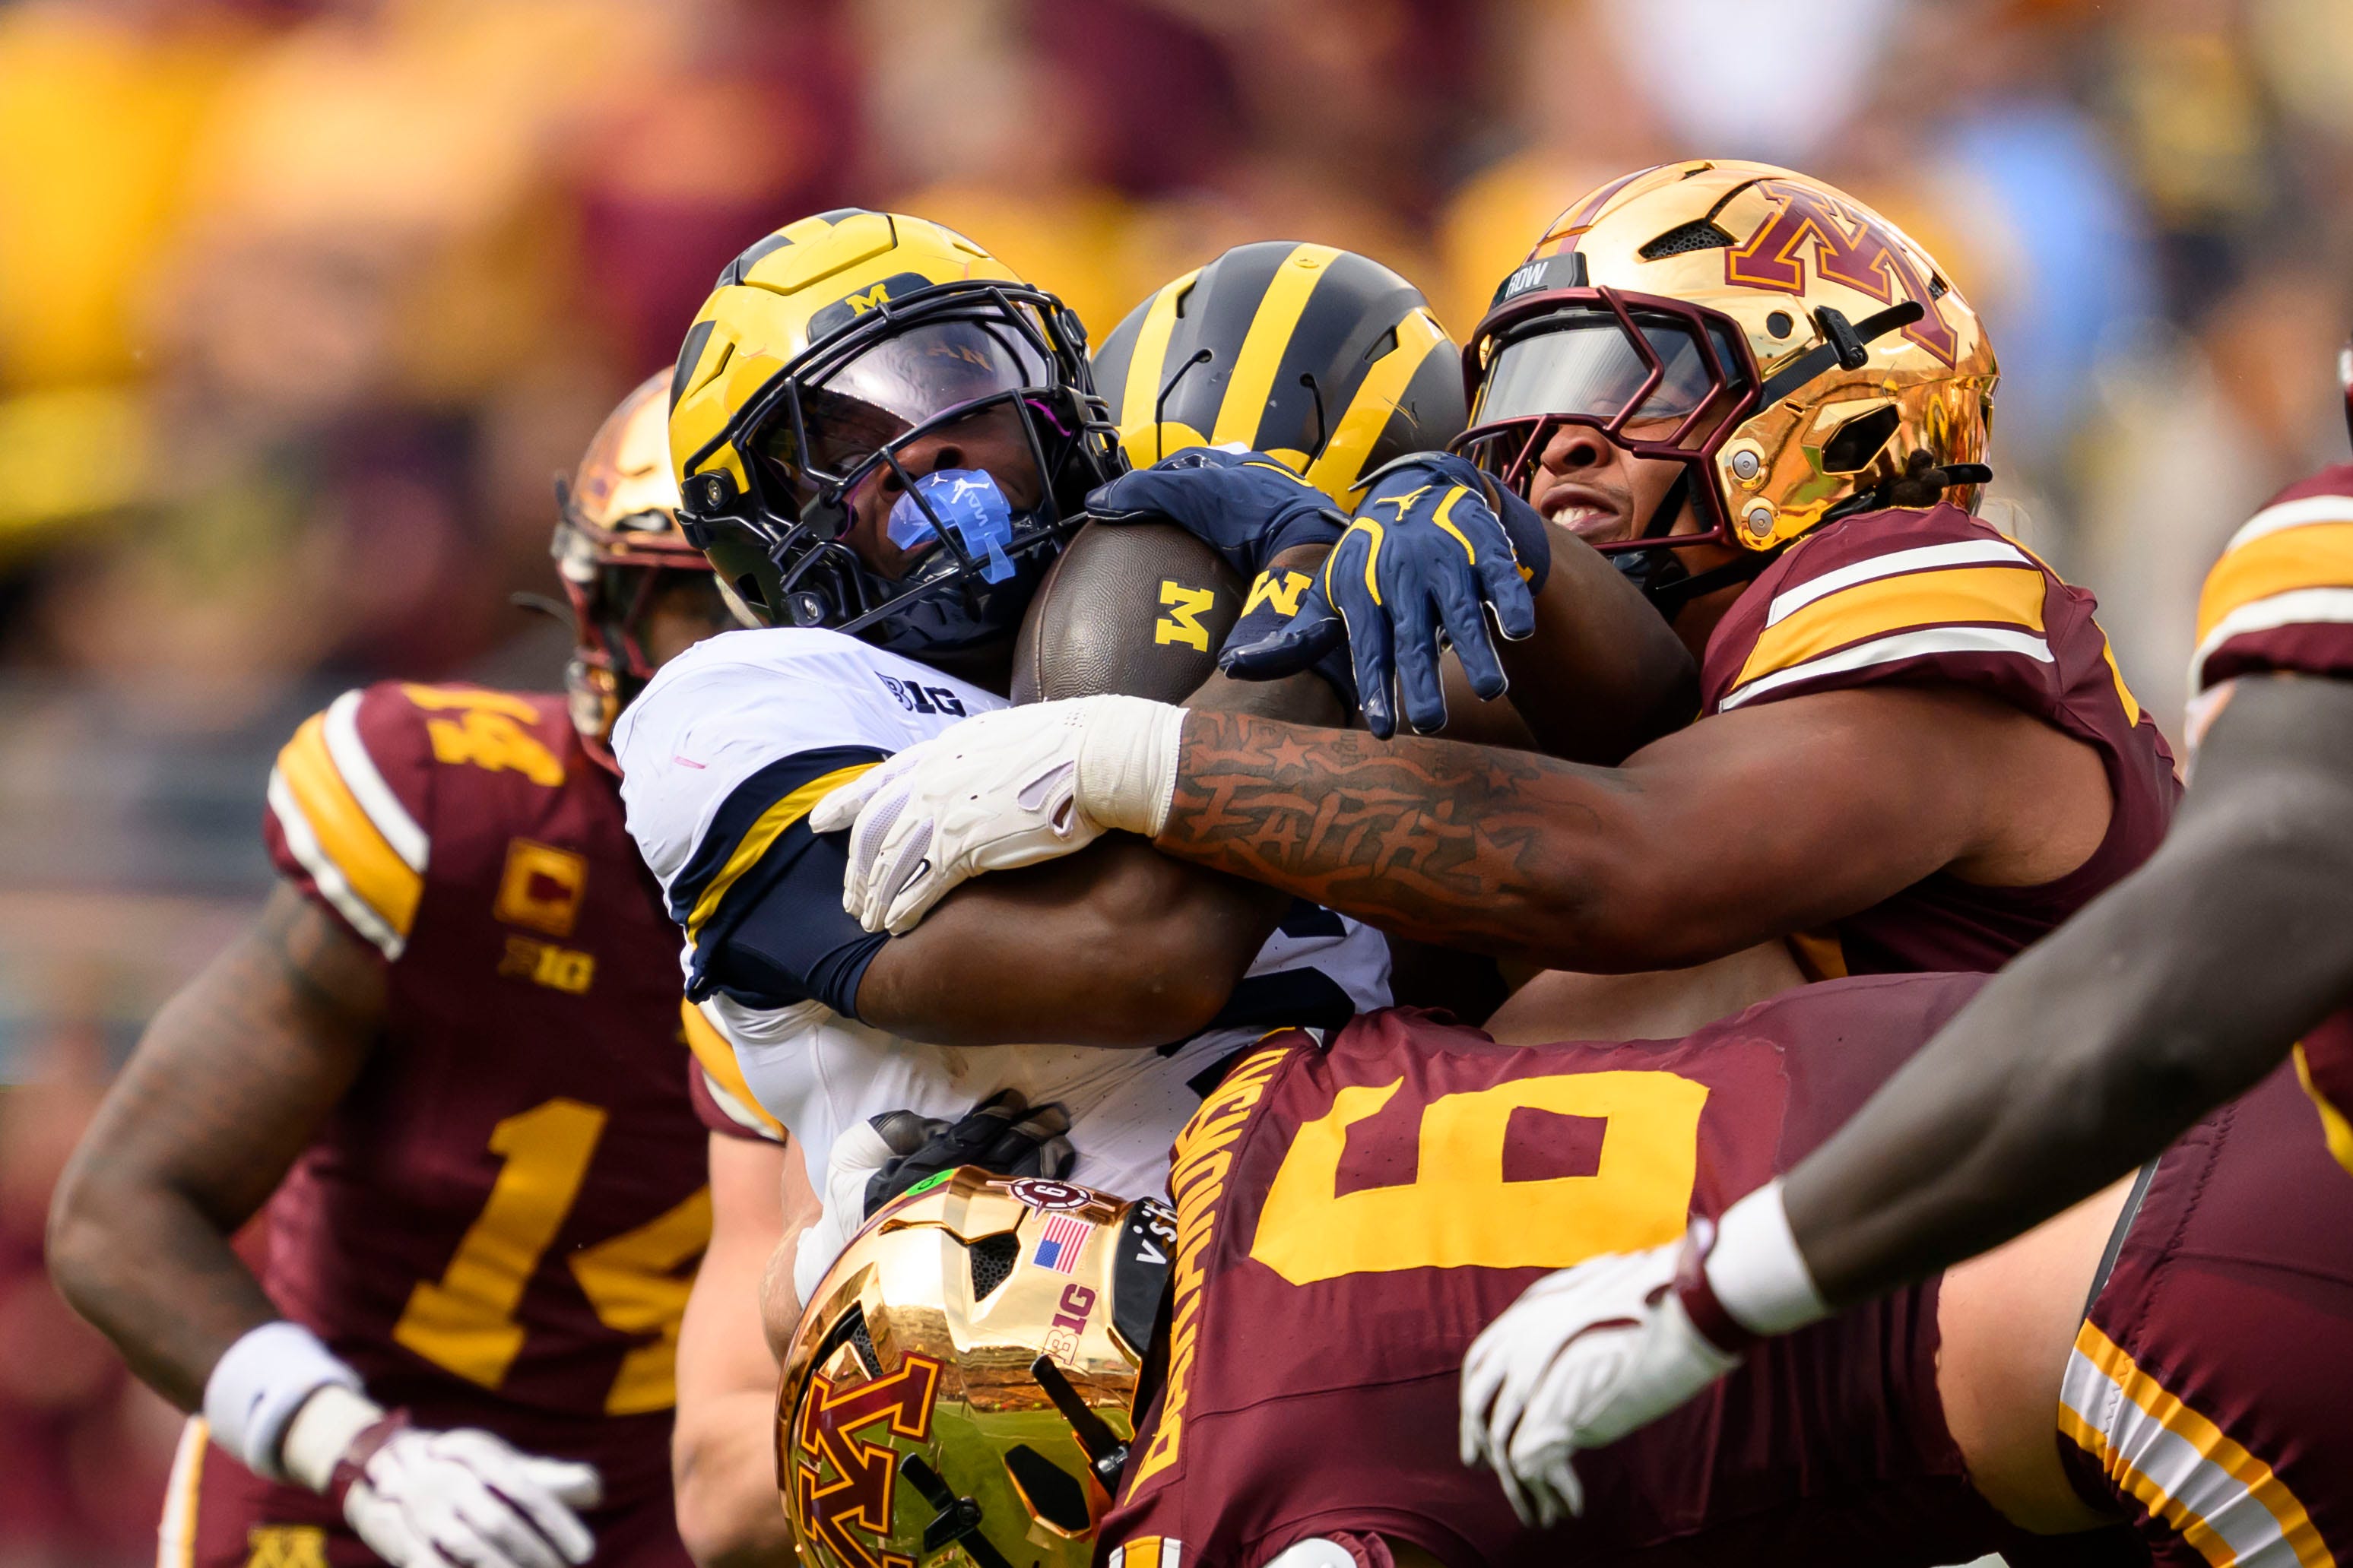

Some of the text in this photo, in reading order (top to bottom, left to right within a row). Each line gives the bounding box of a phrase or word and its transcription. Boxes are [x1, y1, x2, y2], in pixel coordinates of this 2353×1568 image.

[845, 283, 892, 318] M
[1505, 261, 1549, 299] ROW
[1725, 179, 1958, 371] M
[1155, 580, 1215, 653] M
[1240, 570, 1313, 619] M
[1249, 1070, 1710, 1286] 6
[393, 1097, 713, 1417] 14
